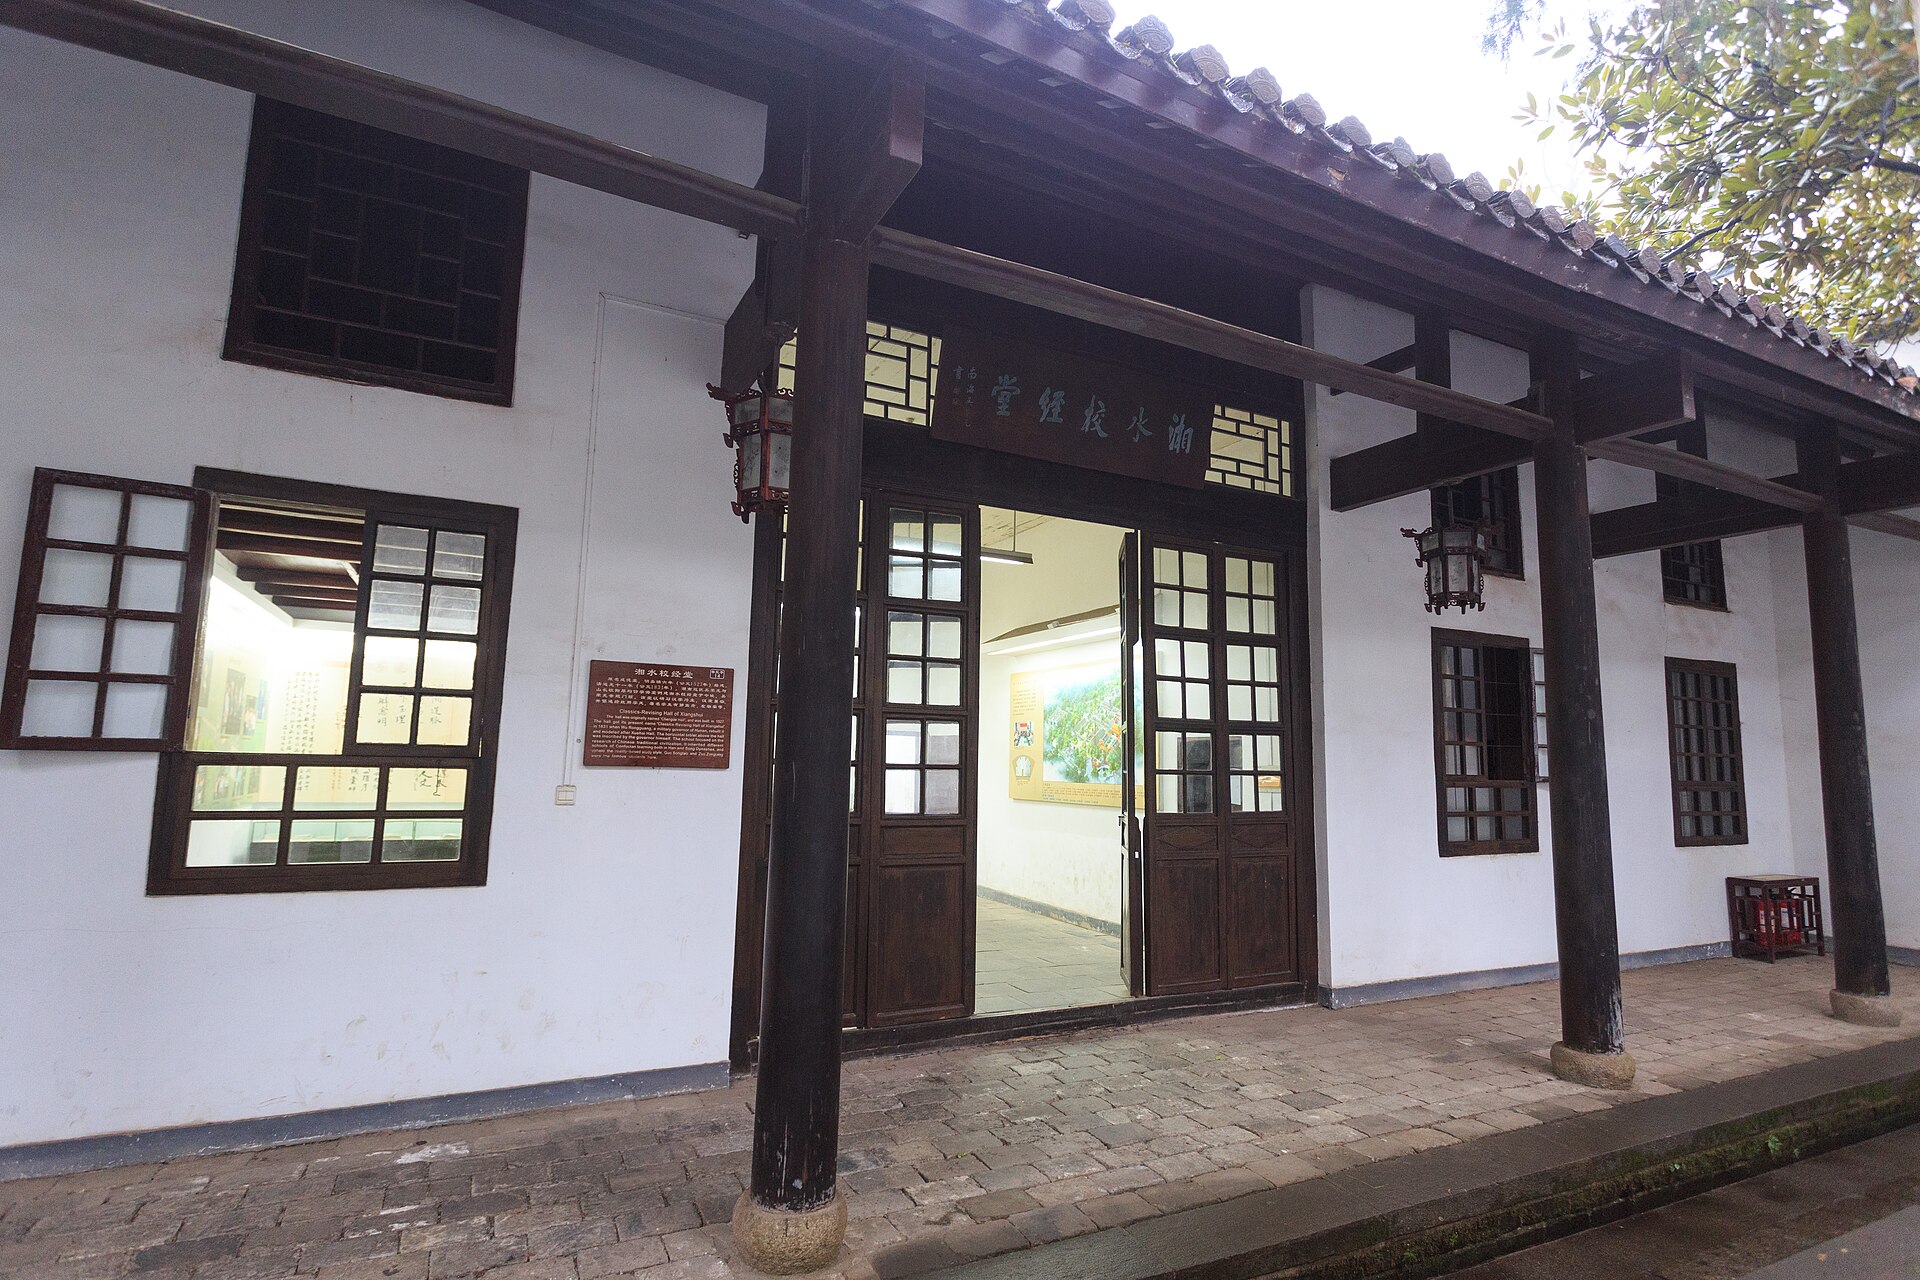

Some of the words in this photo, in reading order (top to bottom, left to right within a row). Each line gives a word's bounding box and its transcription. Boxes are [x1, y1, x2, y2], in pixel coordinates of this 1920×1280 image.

[635, 668, 693, 679] 湘水校经堂
